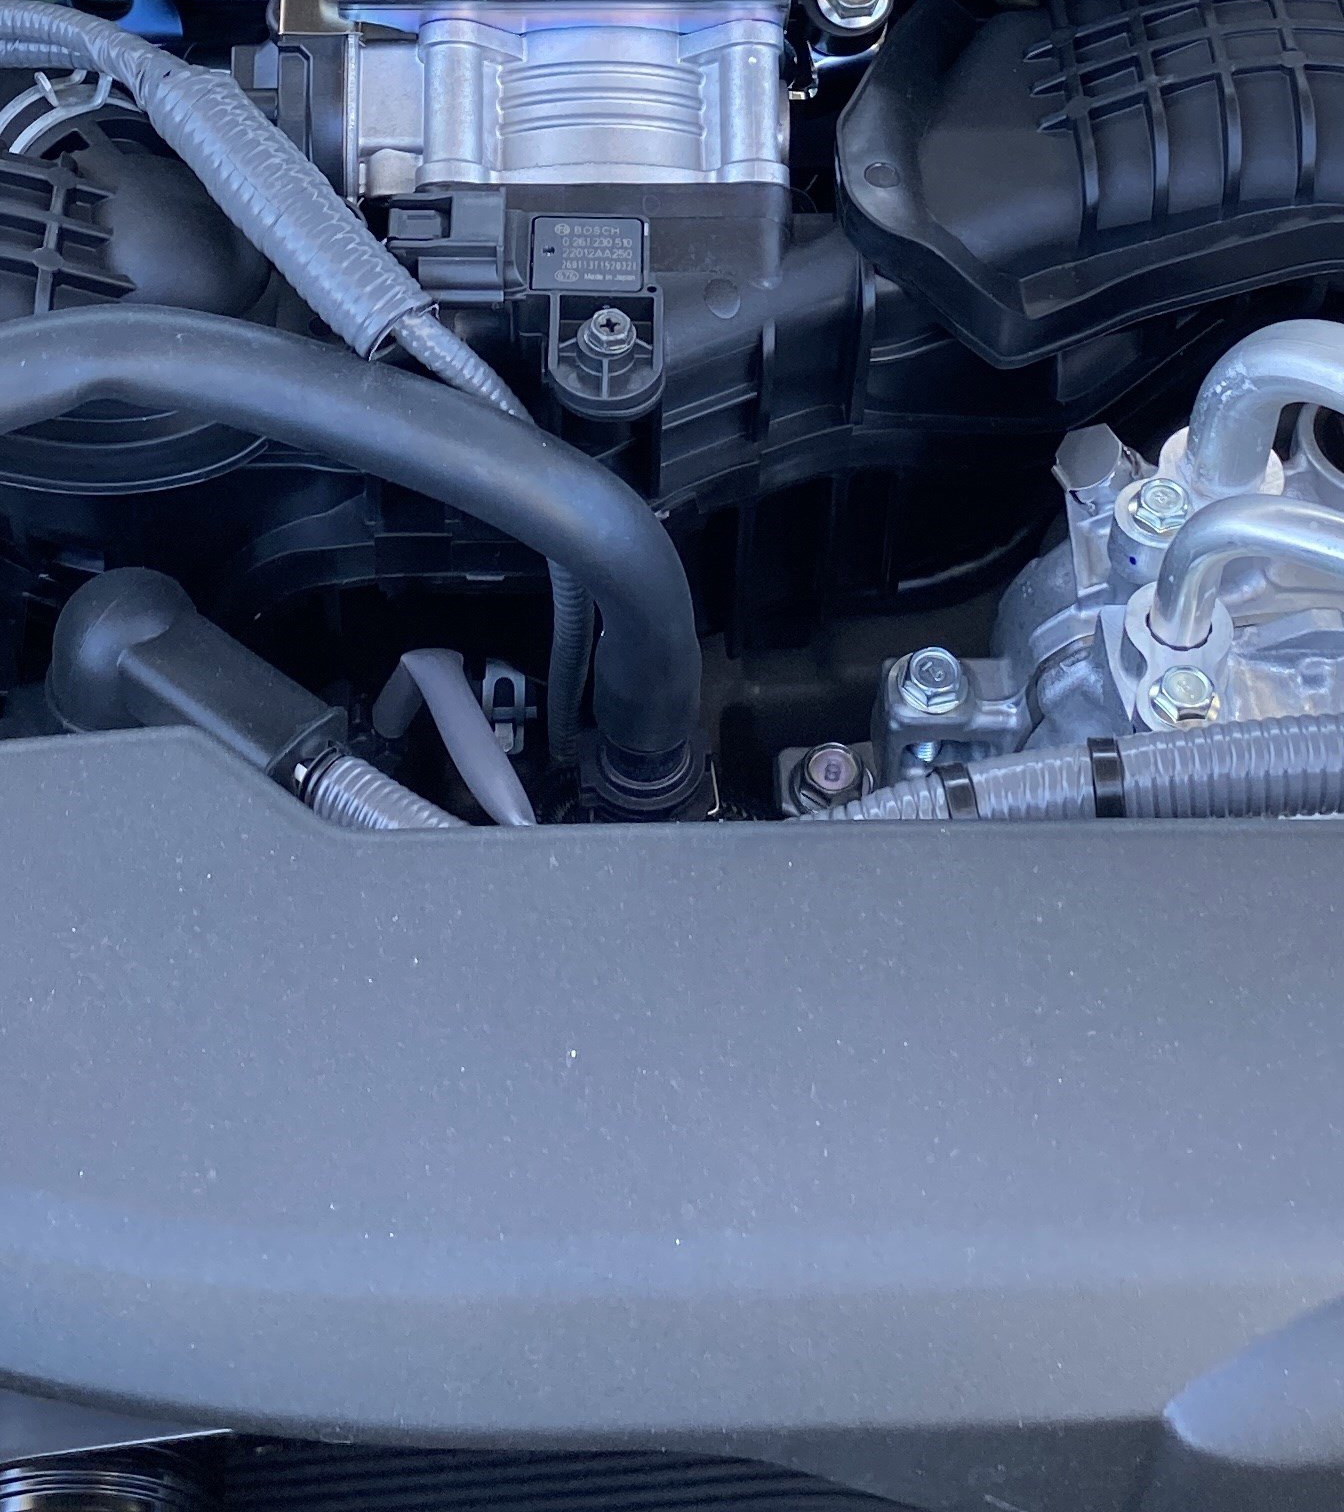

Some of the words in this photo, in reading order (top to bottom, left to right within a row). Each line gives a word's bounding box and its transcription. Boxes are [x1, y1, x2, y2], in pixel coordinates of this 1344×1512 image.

[573, 226, 620, 236] BOSCH
[584, 273, 604, 281] Made
[605, 273, 612, 281] in
[614, 273, 636, 282] Japan
